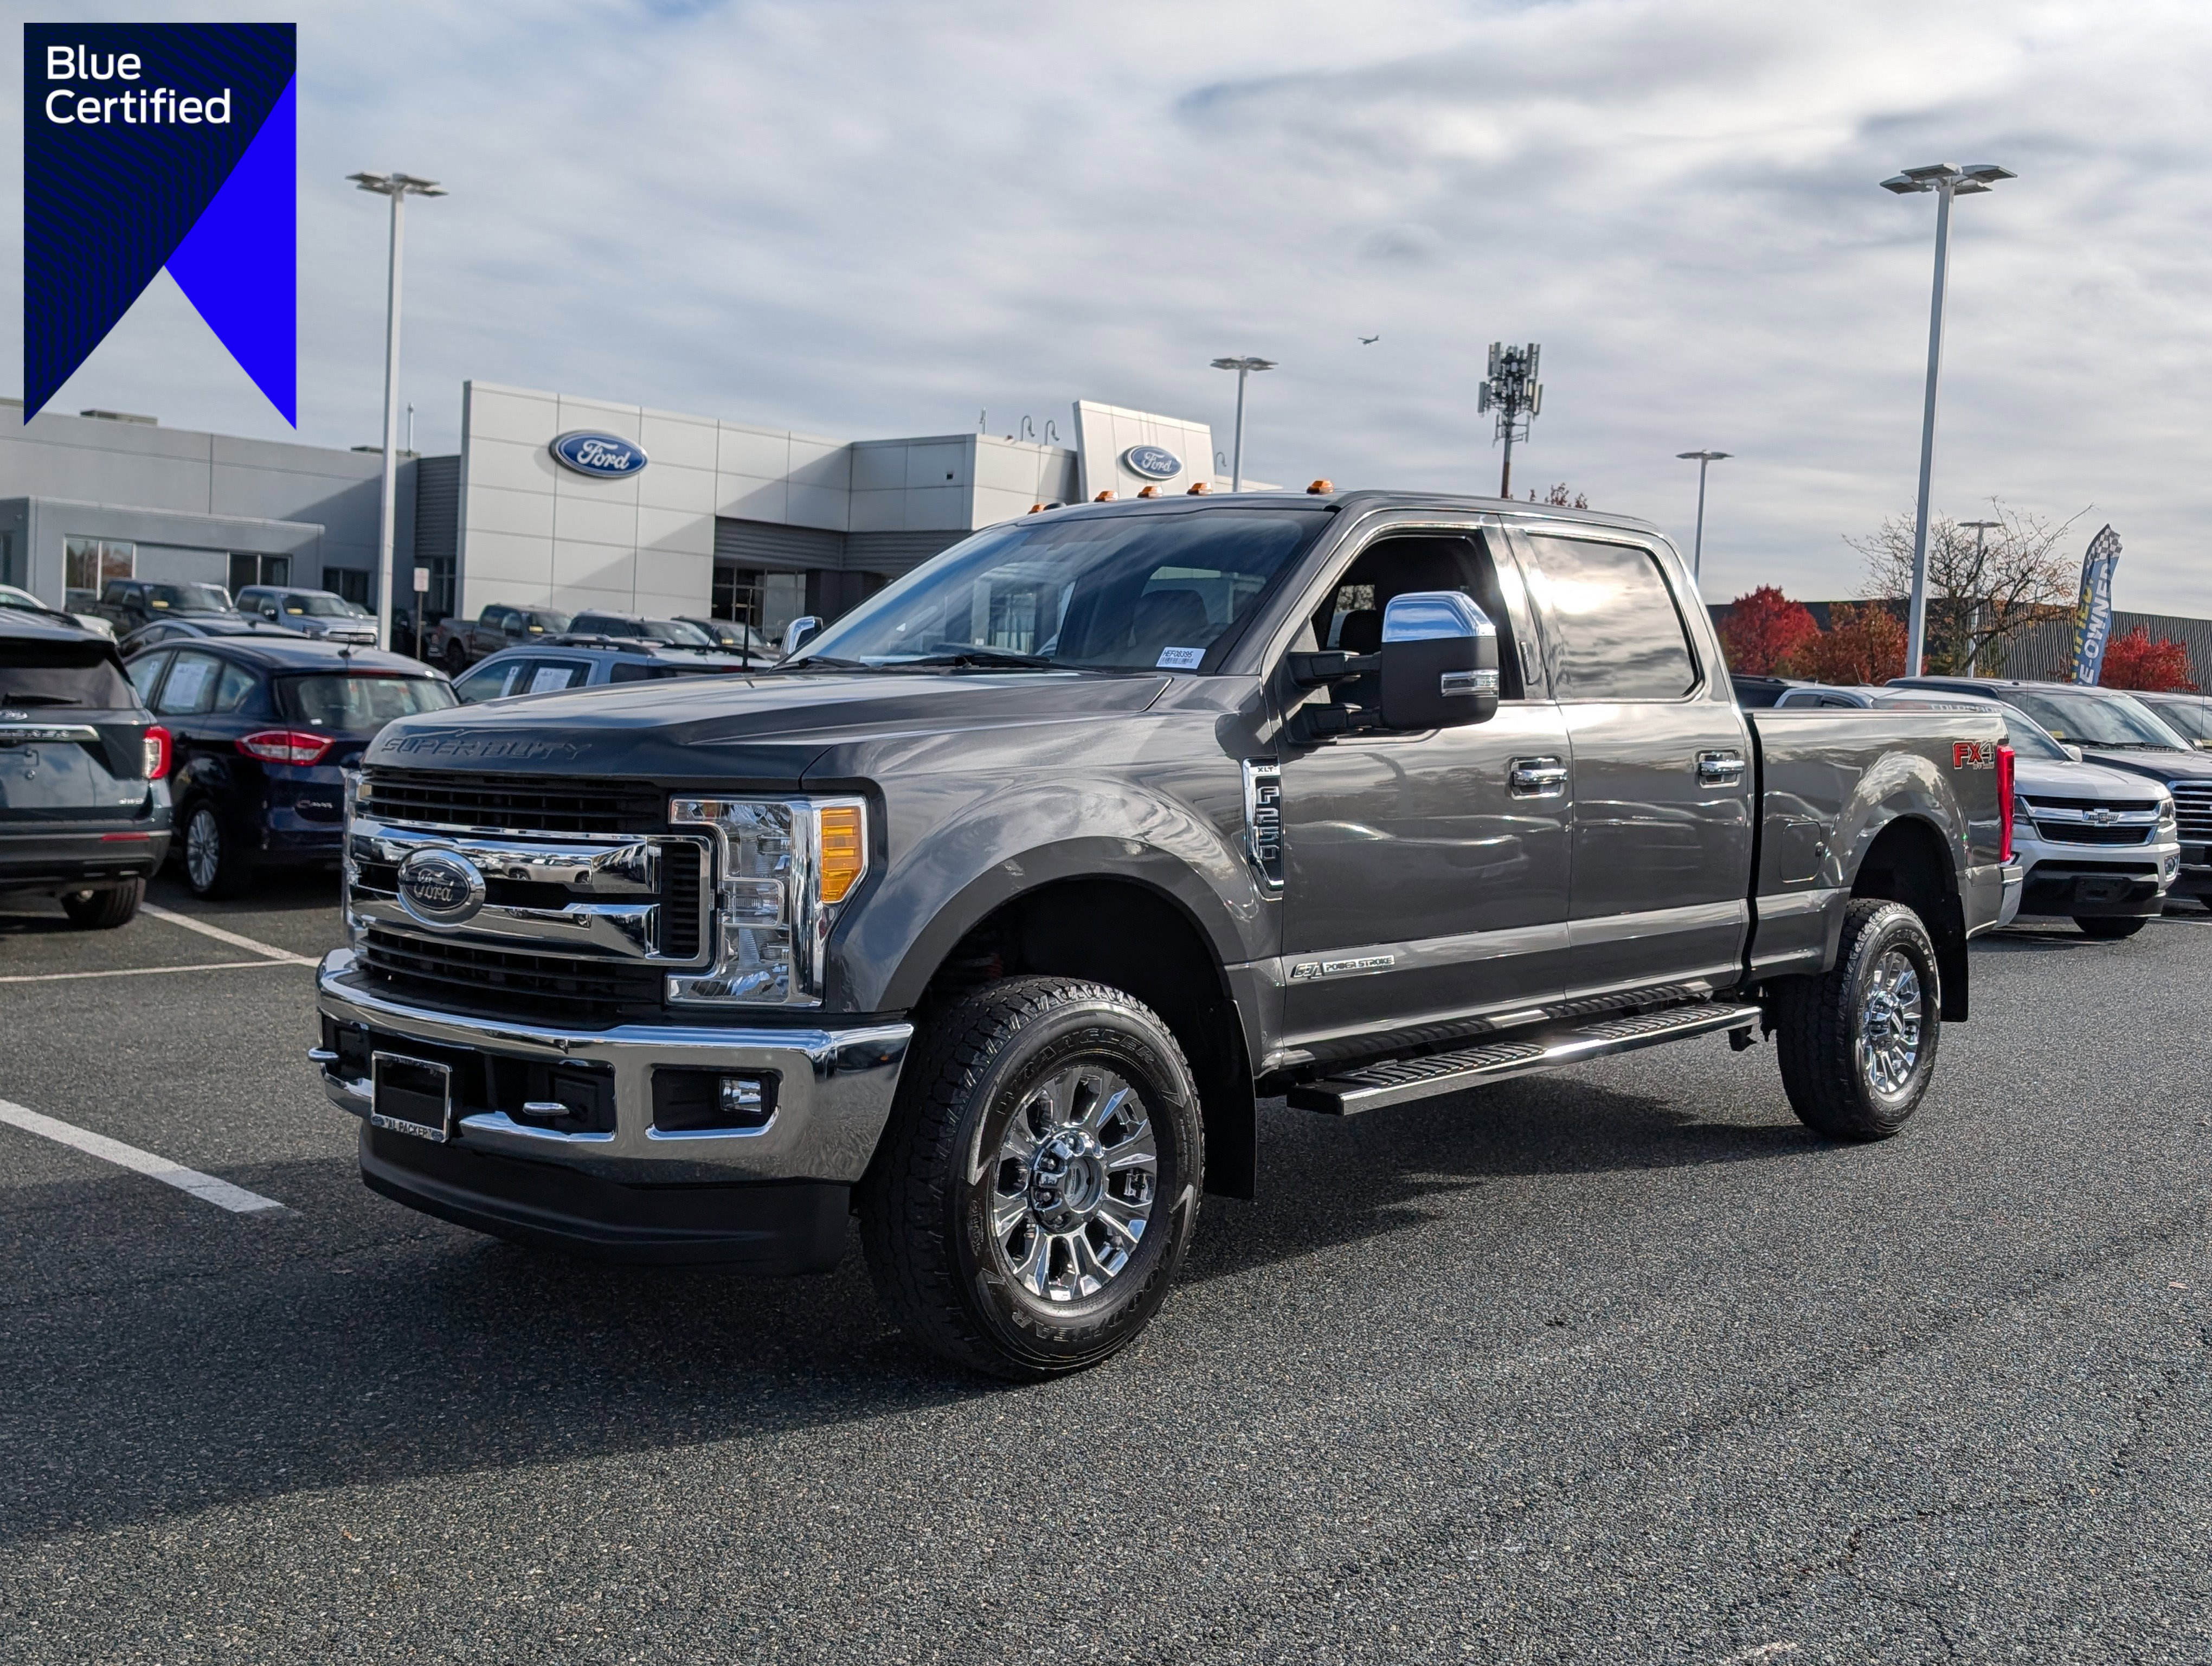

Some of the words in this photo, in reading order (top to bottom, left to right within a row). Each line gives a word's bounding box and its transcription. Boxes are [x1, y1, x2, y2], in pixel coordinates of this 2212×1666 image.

[577, 439, 631, 470] Ford
[1141, 451, 1173, 472] Ford
[381, 738, 481, 757] SUPER
[481, 741, 593, 759] DUTY
[1952, 740, 1996, 770] FX4
[413, 868, 455, 902] Ford
[1326, 961, 1356, 971] POWER
[1358, 957, 1392, 967] STROKE
